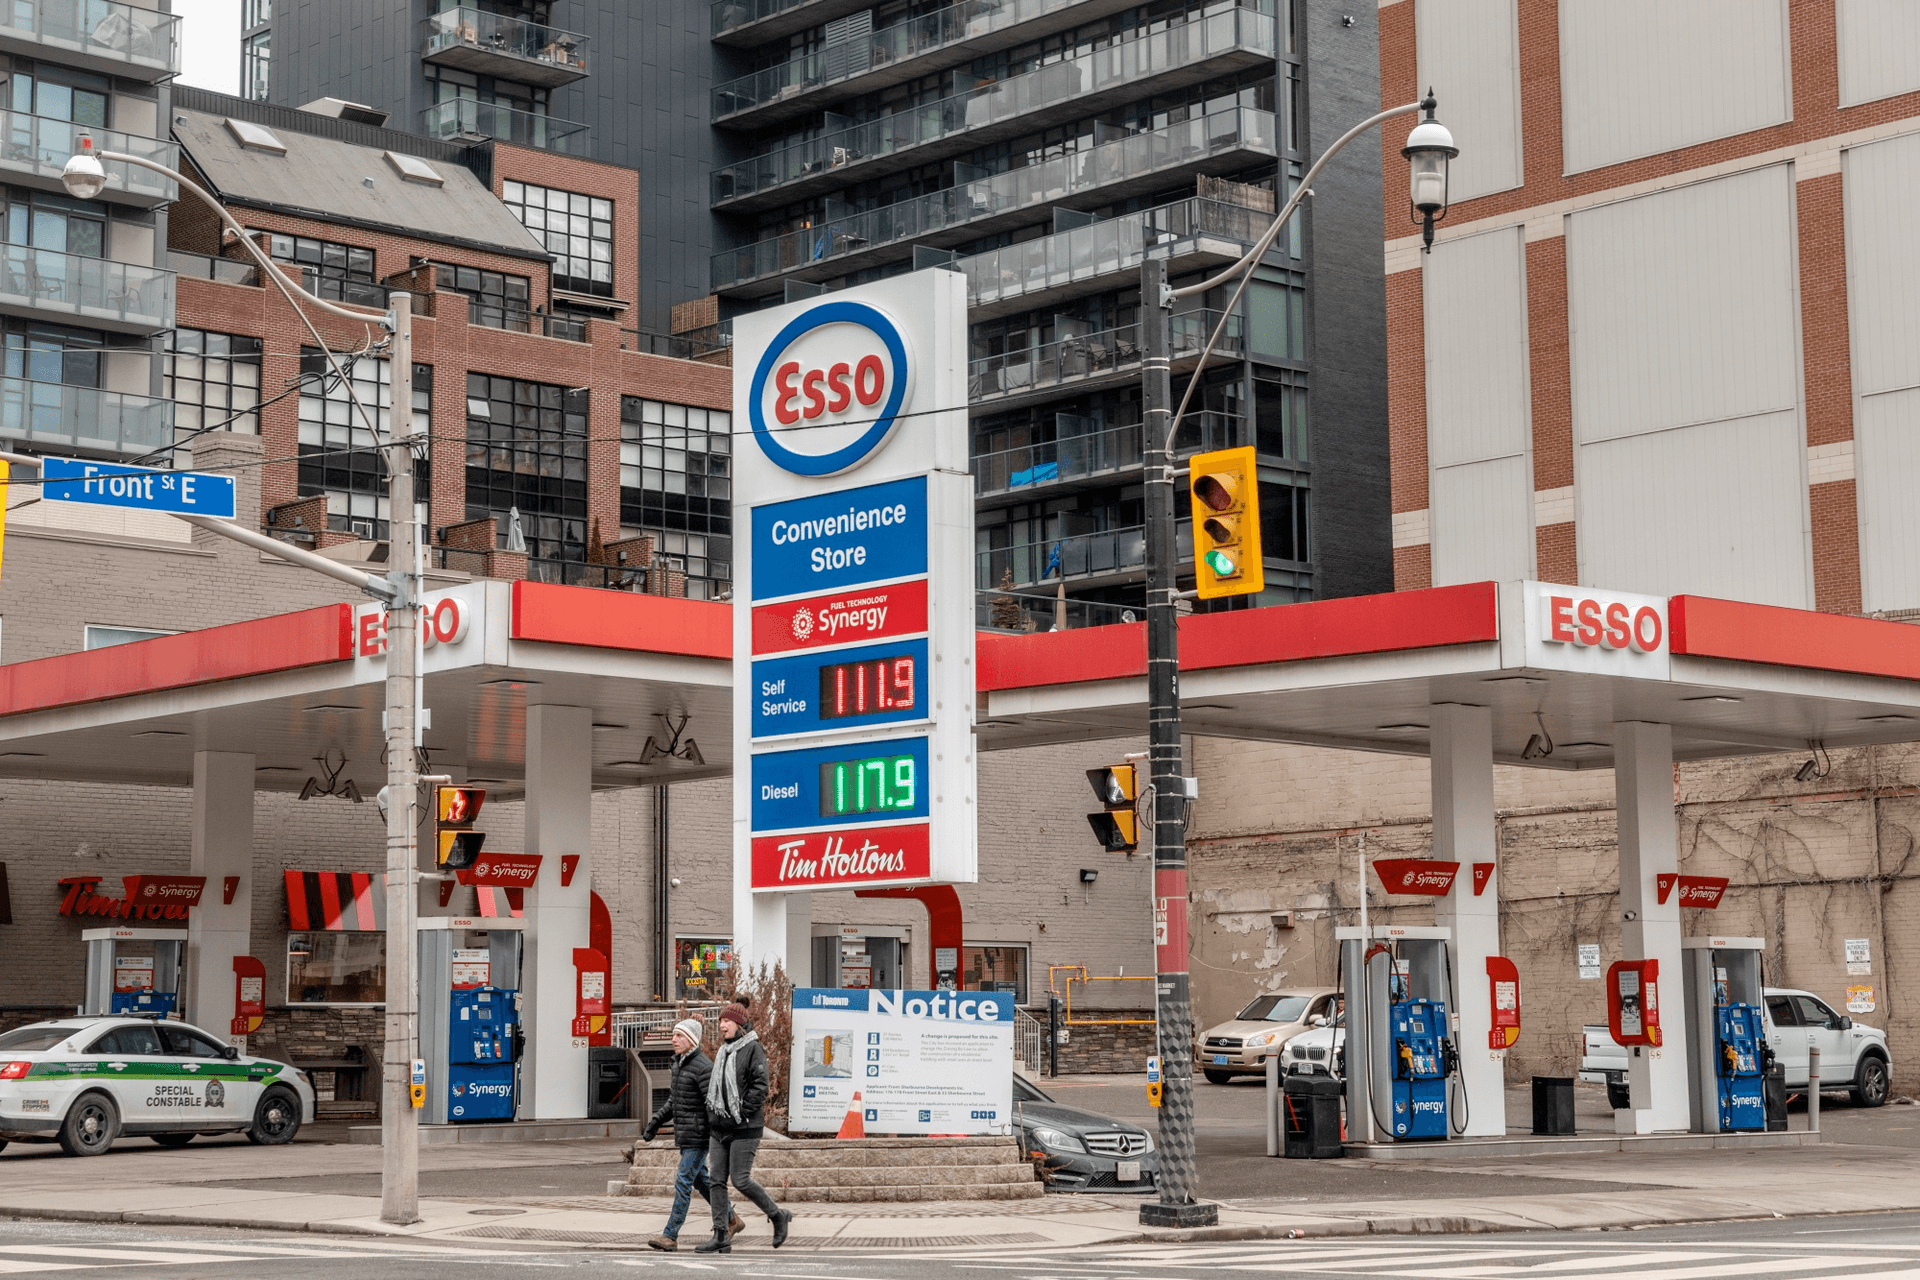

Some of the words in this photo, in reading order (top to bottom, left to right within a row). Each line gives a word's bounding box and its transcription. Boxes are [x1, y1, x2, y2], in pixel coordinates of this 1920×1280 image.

[775, 354, 884, 425] ESSO
[84, 466, 154, 500] Front
[161, 475, 175, 490] St
[181, 476, 196, 504] E
[772, 503, 906, 545] Convenience
[811, 545, 866, 572] Store
[830, 601, 846, 610] FUEL
[846, 595, 888, 608] TECHNOLOGY
[360, 597, 459, 657] EO
[819, 605, 888, 636] Synergy
[1551, 596, 1662, 652] ESSO
[762, 699, 806, 716] Service
[836, 658, 914, 715] 111.9
[762, 679, 785, 697] Self
[761, 783, 798, 801] Diesel
[836, 758, 915, 813] 117.9
[777, 840, 817, 882] Tim
[821, 835, 904, 877] Hortons
[491, 865, 536, 880] Synergy
[562, 863, 567, 872] 8
[1475, 870, 1483, 879] 12
[1415, 873, 1452, 887] Synergy
[1659, 880, 1667, 888] 10
[159, 885, 200, 898] Synergy
[224, 884, 229, 892] 4
[441, 887, 445, 895] 2
[1689, 887, 1720, 901] Synergy
[58, 876, 120, 919] Tim
[869, 989, 999, 1021] Notice
[1438, 1005, 1445, 1013] 12
[155, 1086, 194, 1095] SPECIAL
[469, 1082, 512, 1097] Synergy
[146, 1097, 202, 1106] CONSTABLE
[1732, 1094, 1761, 1108] Synergy
